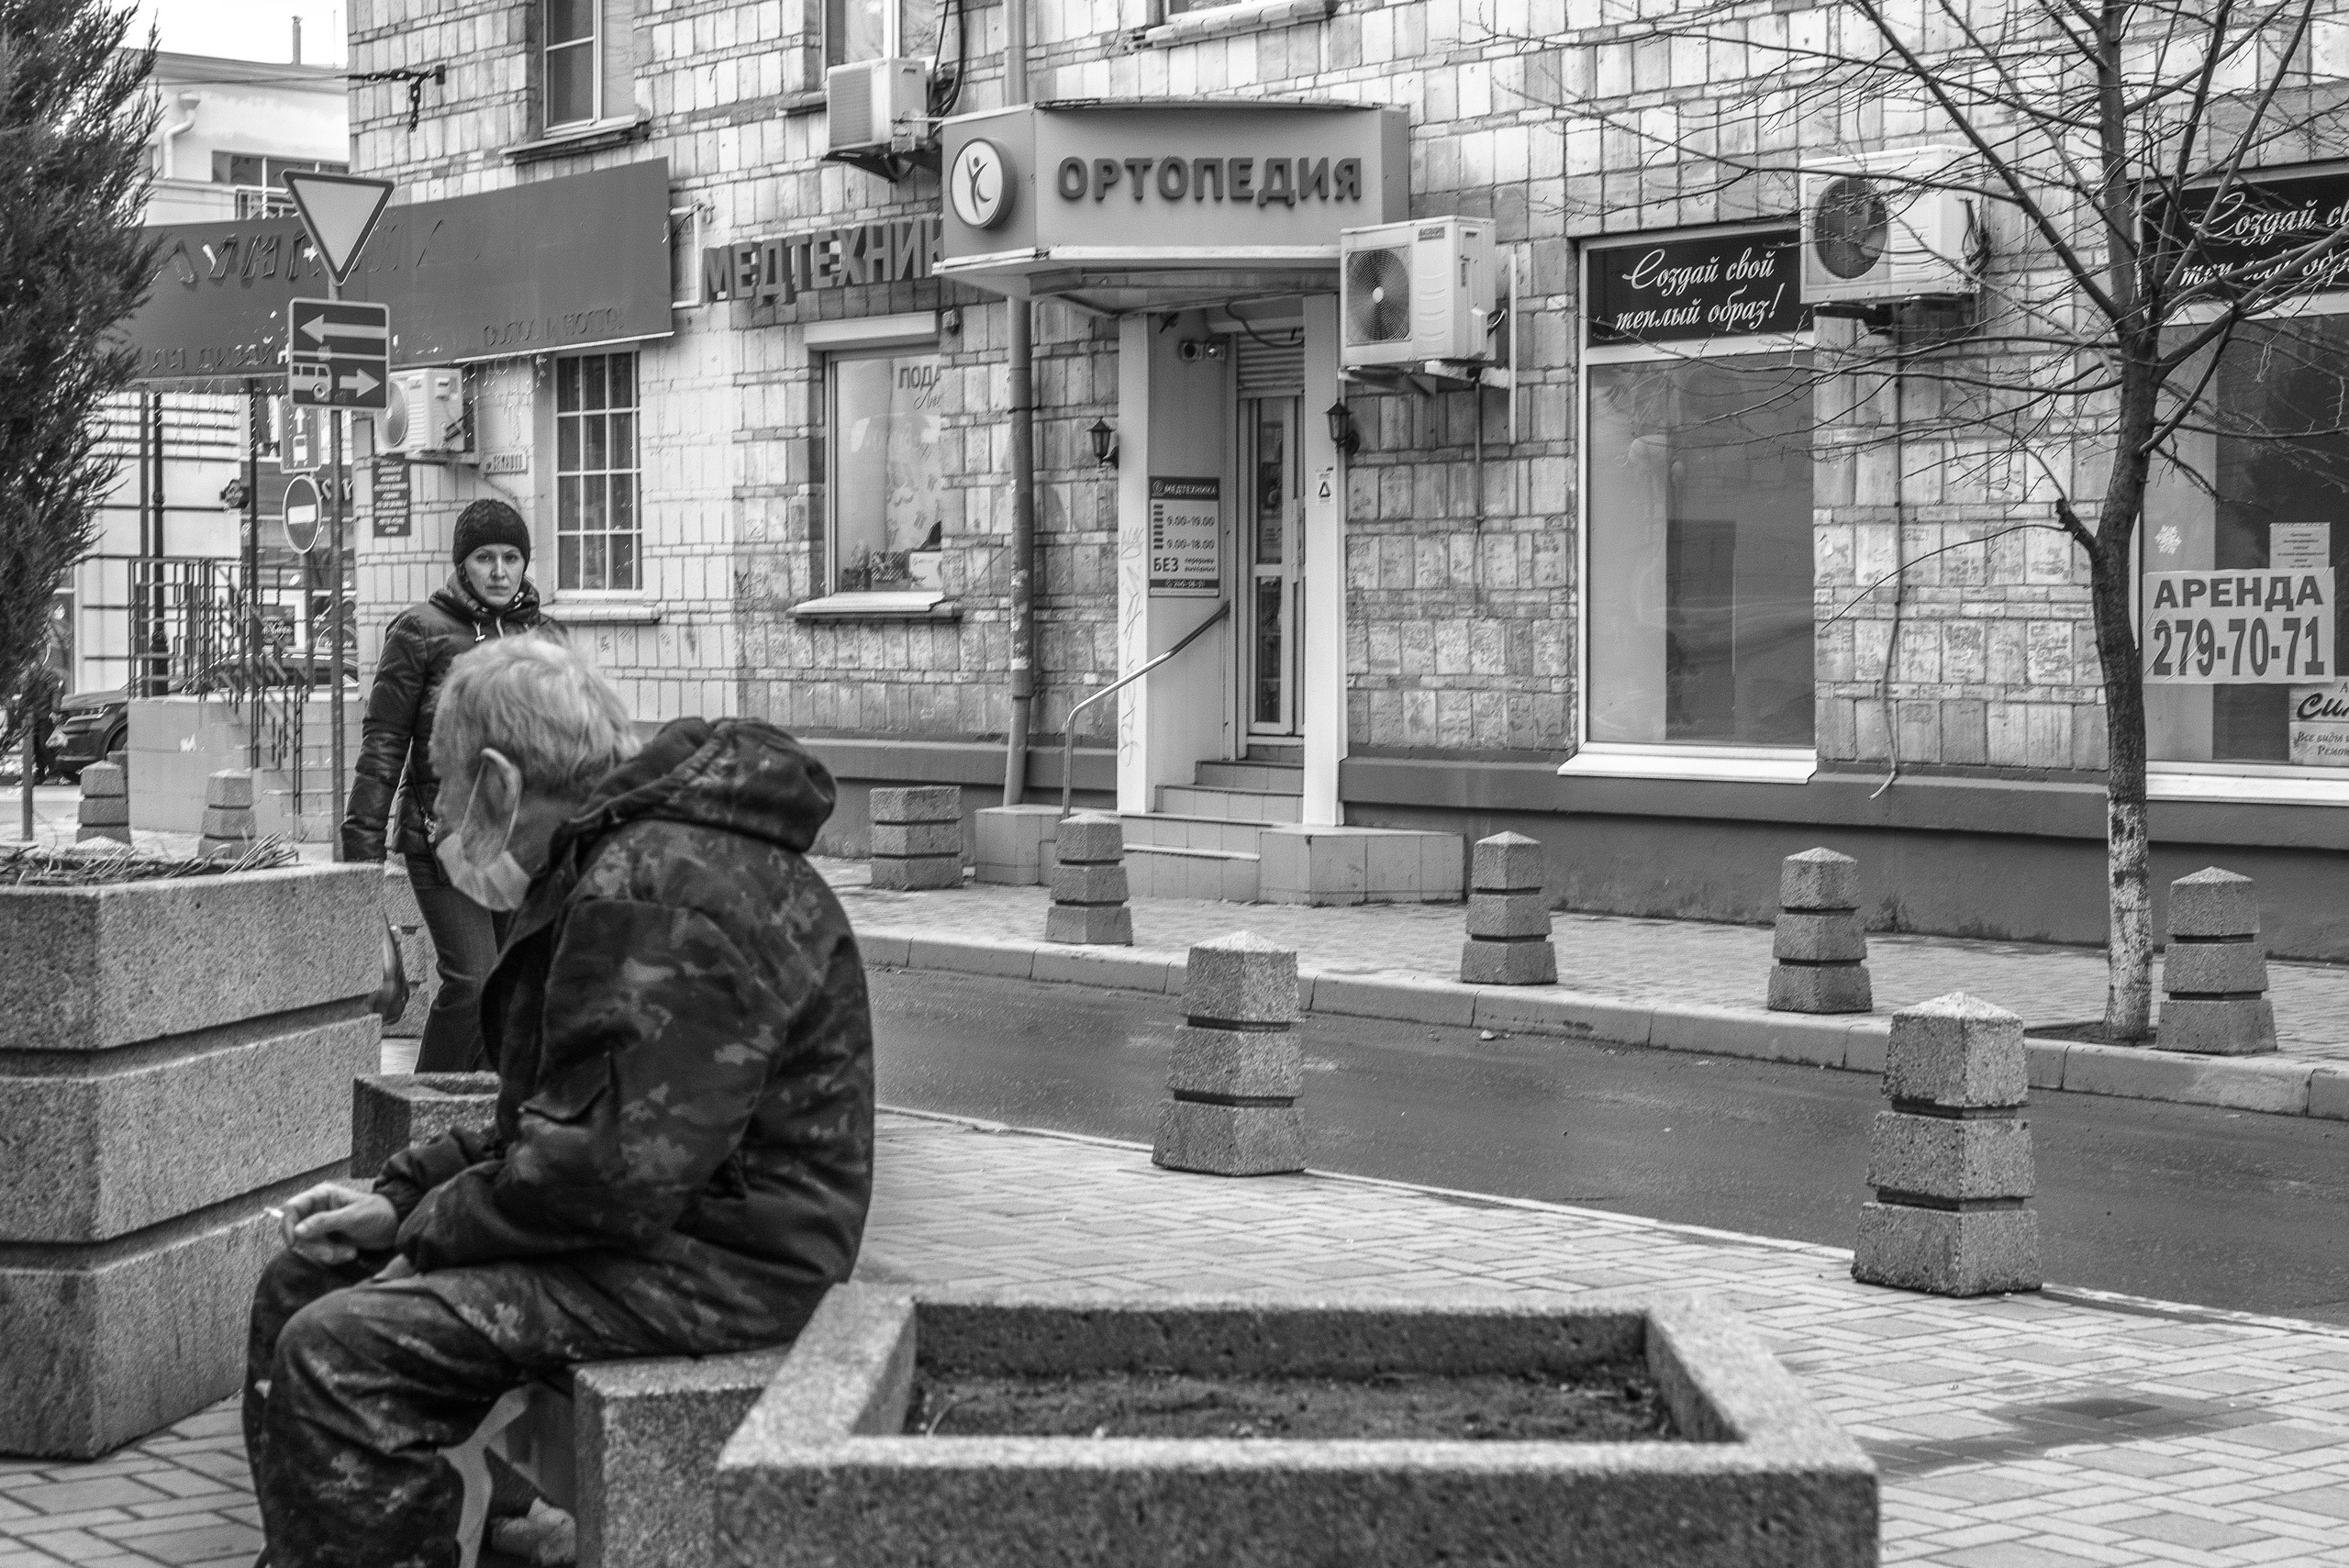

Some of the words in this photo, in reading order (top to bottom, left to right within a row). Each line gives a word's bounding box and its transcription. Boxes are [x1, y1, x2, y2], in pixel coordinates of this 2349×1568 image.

[1058, 156, 1362, 206] ОРТОПЕДИЯ
[1621, 248, 1720, 296] Создай
[1726, 247, 1776, 281] свой
[1615, 298, 1702, 330] теплый
[1708, 283, 1785, 331] образ!
[1163, 484, 1218, 495] МЕДТЕХНИКА
[1153, 556, 1179, 573] БЕЗ
[2154, 575, 2323, 613] АРЕНДА
[2153, 617, 2325, 676] 279-70-71
[2296, 692, 2349, 719] Си
